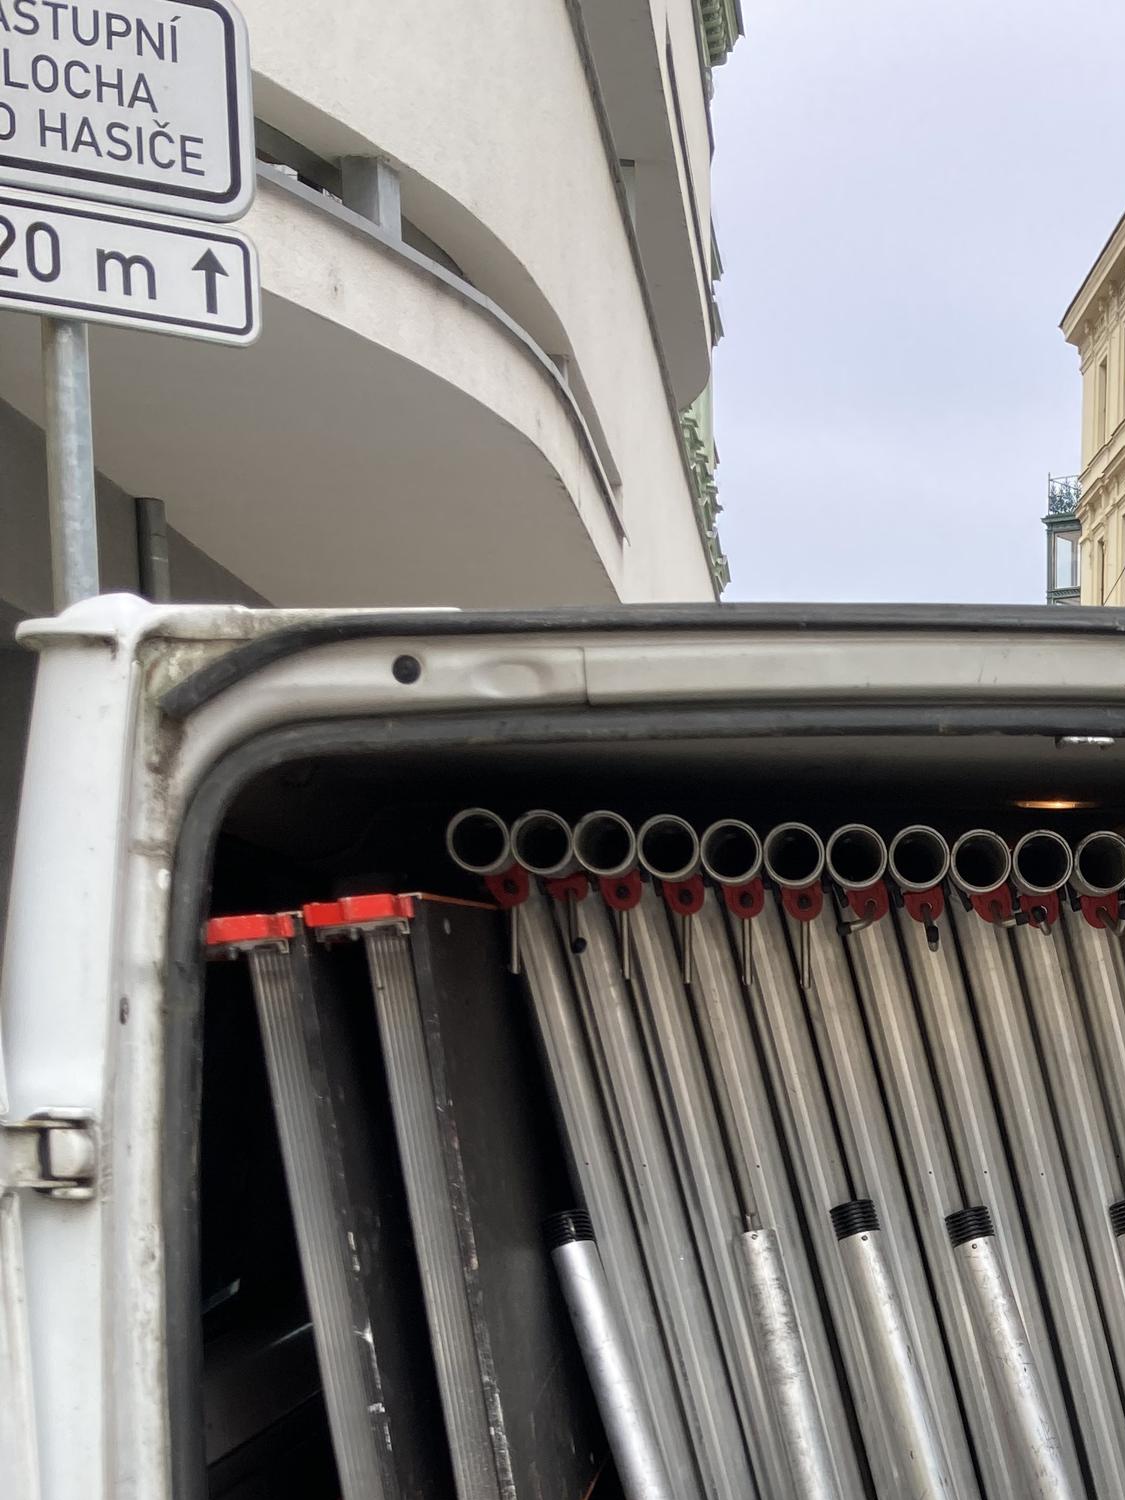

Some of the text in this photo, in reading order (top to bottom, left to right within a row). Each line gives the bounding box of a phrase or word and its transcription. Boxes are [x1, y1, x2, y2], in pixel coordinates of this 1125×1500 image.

[3, 48, 159, 114] LOCHA
[38, 108, 206, 177] HASIČE
[96, 247, 157, 300] m
